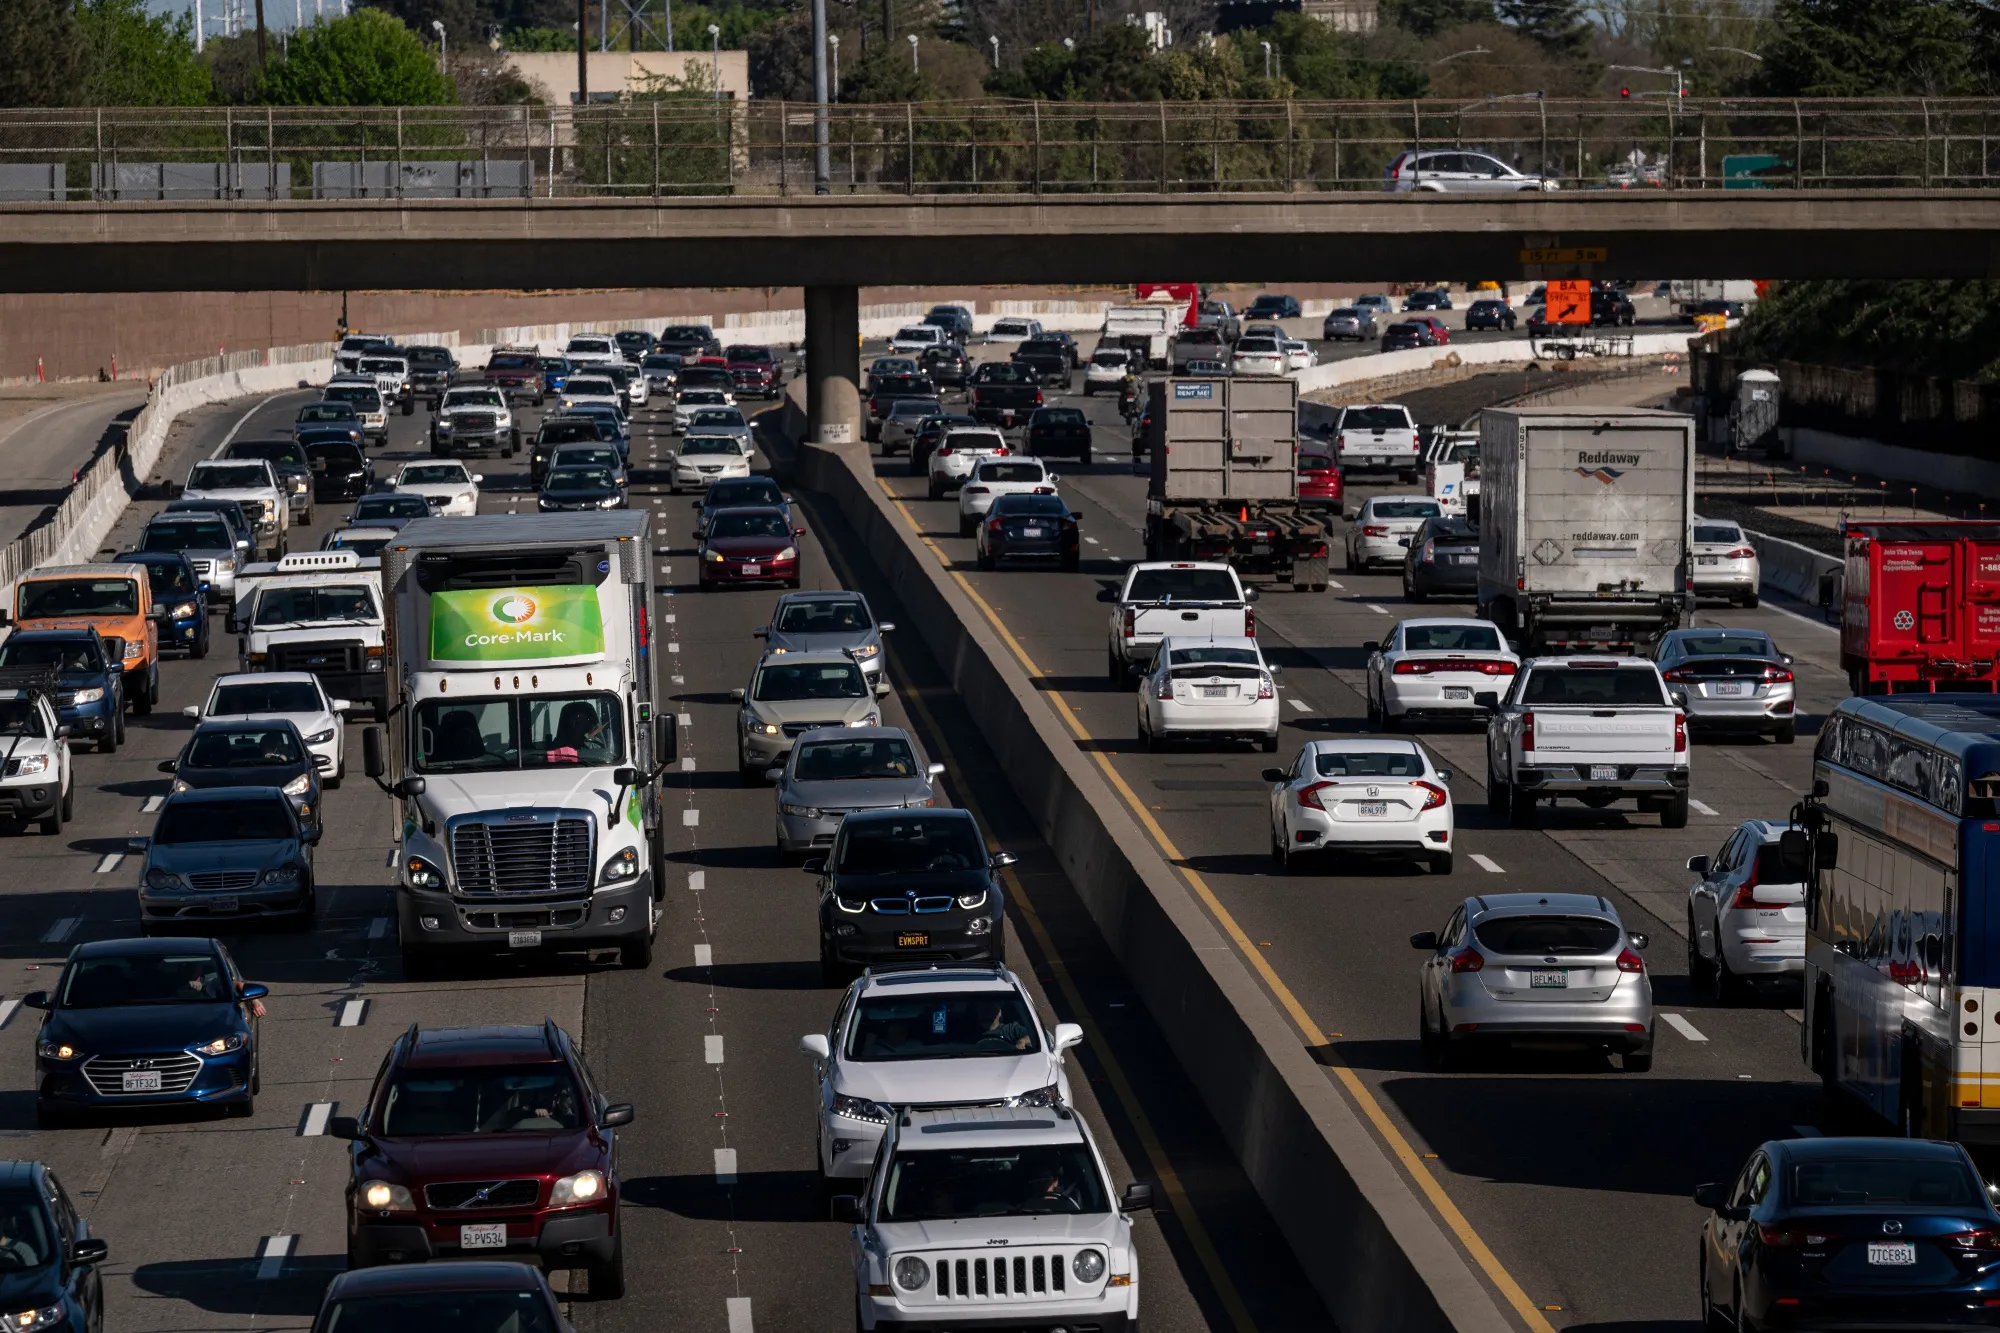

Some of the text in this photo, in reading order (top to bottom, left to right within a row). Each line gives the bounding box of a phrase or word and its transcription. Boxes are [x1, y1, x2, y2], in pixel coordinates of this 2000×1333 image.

[1530, 250, 1598, 260] 15 FT 5 IN
[1578, 451, 1640, 466] Reddaway
[1572, 531, 1639, 542] reddaway.com
[1544, 723, 1663, 733] CHEVROLET
[898, 936, 928, 946] EVMSPRT
[126, 1078, 159, 1089] 8FTF321
[464, 1232, 503, 1245] 5LPV534
[987, 1238, 1009, 1246] Jeep
[1870, 1249, 1913, 1262] 7TCE851
